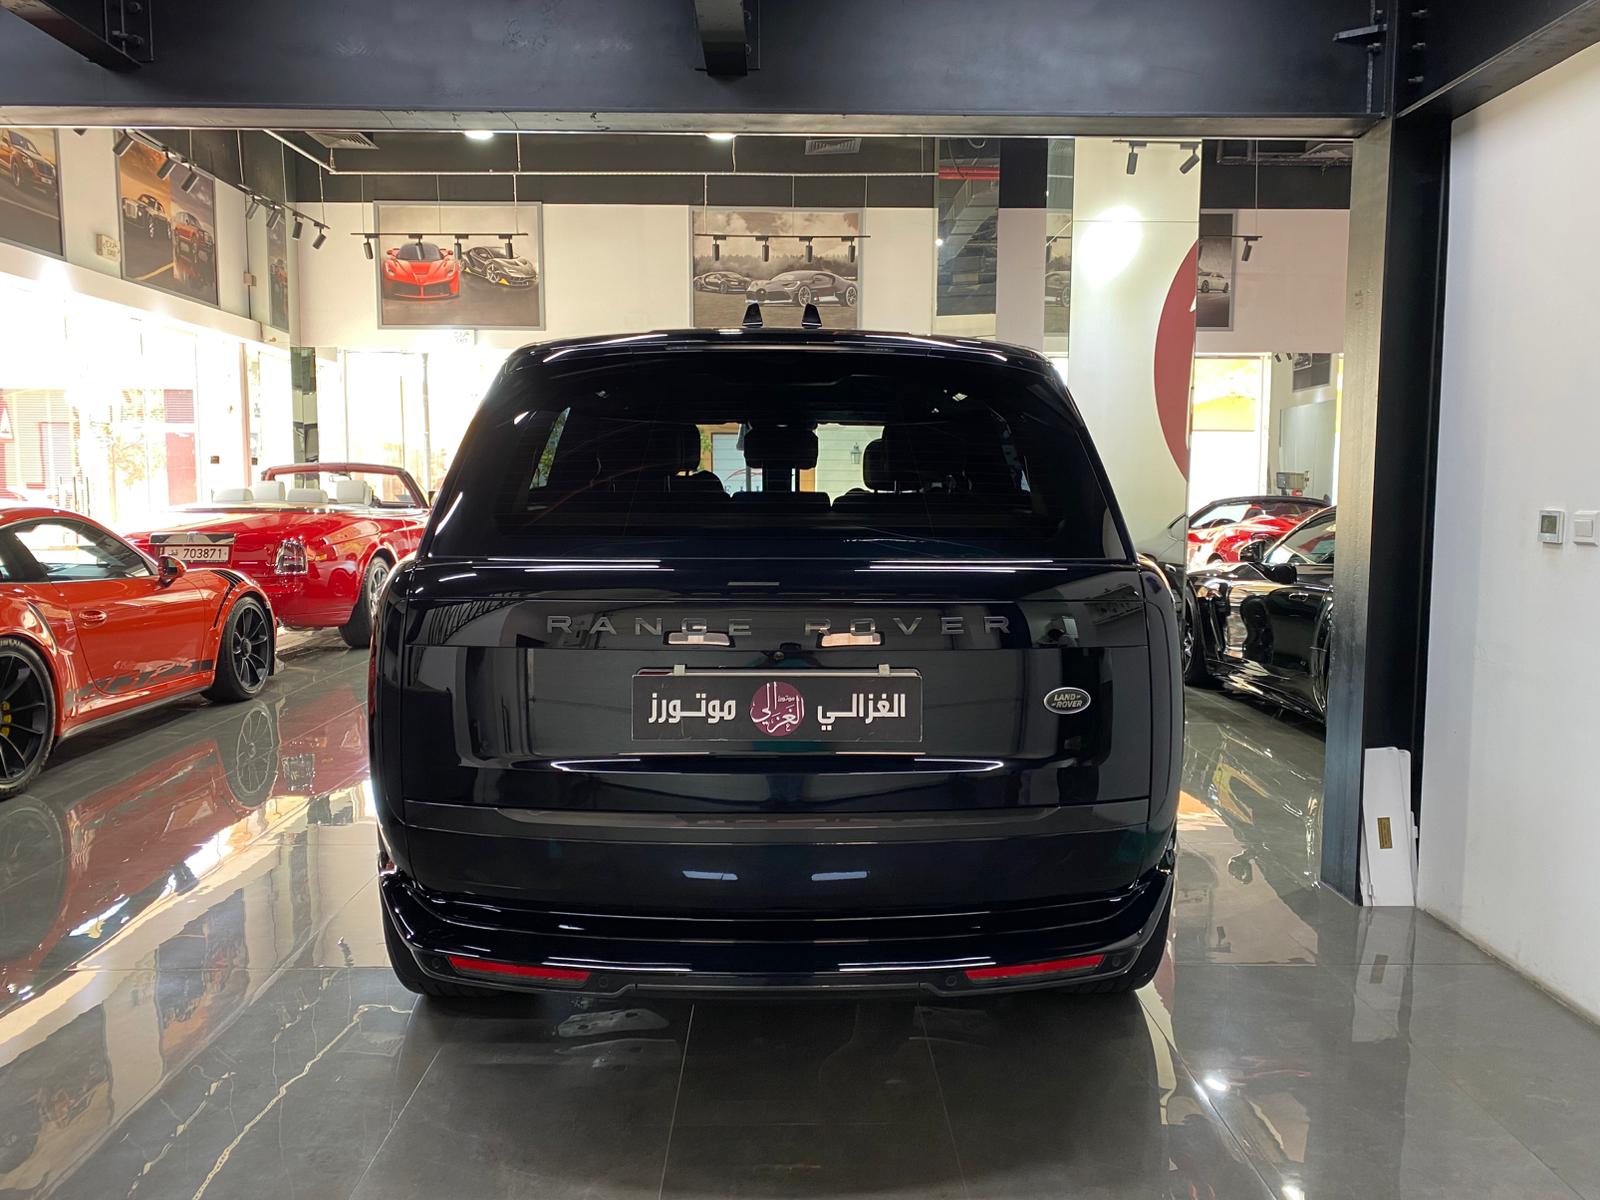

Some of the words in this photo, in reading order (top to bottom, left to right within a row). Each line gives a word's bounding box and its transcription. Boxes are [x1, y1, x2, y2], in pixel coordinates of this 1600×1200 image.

[183, 548, 222, 559] 703871
[546, 615, 752, 637] RANGE
[804, 615, 1011, 637] ROVER
[648, 692, 737, 724] موتورز
[817, 693, 906, 731] الغزالي
